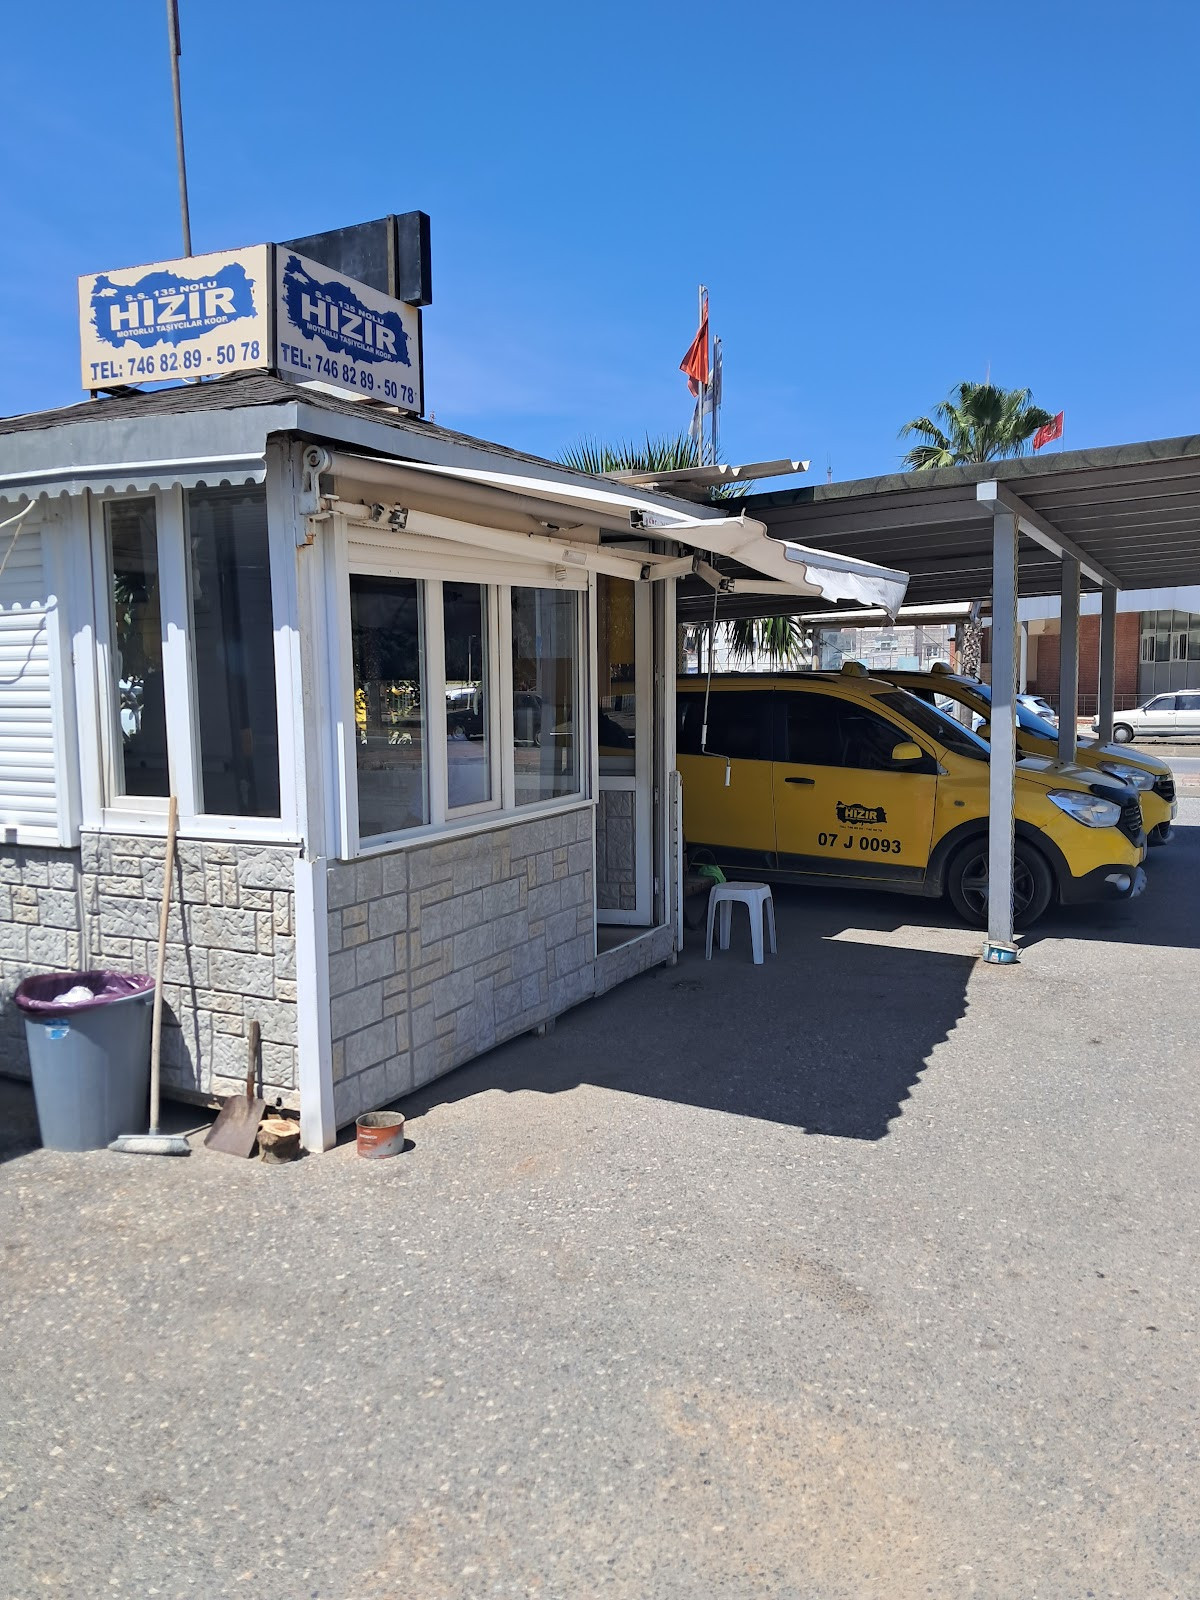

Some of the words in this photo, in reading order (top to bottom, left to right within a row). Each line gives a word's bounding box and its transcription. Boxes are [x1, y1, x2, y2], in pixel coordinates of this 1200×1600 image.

[110, 286, 237, 331] HIZIR
[125, 292, 148, 302] S.S.
[153, 287, 176, 297] 135
[180, 281, 217, 293] NOLU
[315, 290, 335, 304] S.S.
[338, 301, 356, 312] 135
[358, 309, 385, 325] NOLU
[117, 327, 154, 338] MOTORLU
[204, 315, 228, 325] KOOP.
[301, 292, 398, 355] HIZIR
[307, 322, 338, 340] MOTORLU
[375, 349, 392, 360] KOOP.
[90, 361, 123, 381] TEL:
[127, 356, 155, 376] 746
[160, 352, 178, 372] 82
[183, 349, 202, 369] 89
[217, 344, 235, 364] 50
[241, 340, 260, 361] 78
[281, 342, 311, 370] TEL:
[315, 354, 338, 379] 746
[342, 363, 356, 385] 82
[360, 370, 374, 391] 89
[384, 379, 398, 399] 50
[400, 385, 414, 404] 78
[818, 832, 838, 847] 07
[843, 835, 853, 848] J
[859, 836, 901, 853] 0093
